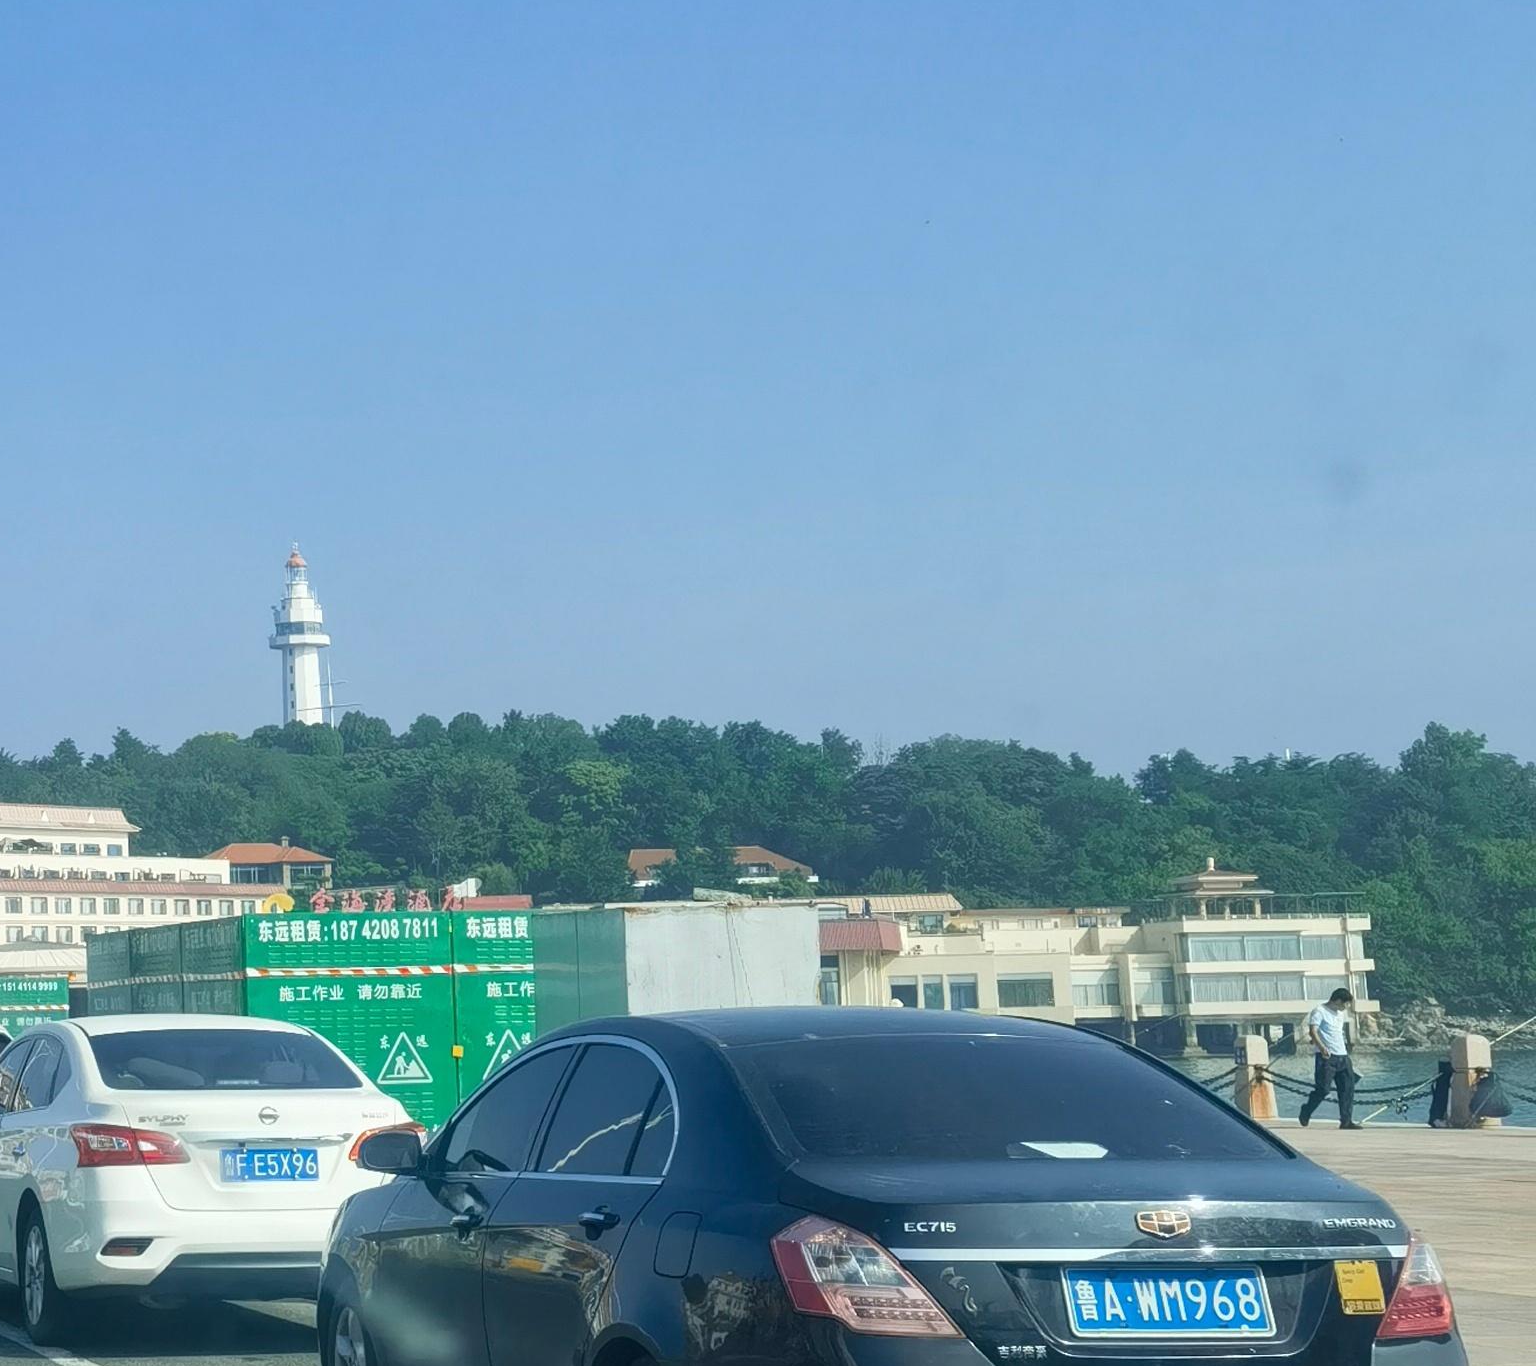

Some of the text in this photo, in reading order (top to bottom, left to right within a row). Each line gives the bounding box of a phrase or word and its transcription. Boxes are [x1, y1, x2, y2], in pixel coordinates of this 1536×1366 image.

[466, 916, 529, 939] 东远租赁
[279, 983, 423, 1002] 施工作业 请勿靠近
[904, 1221, 957, 1233] EC715
[1323, 1217, 1397, 1229] EMGRAND
